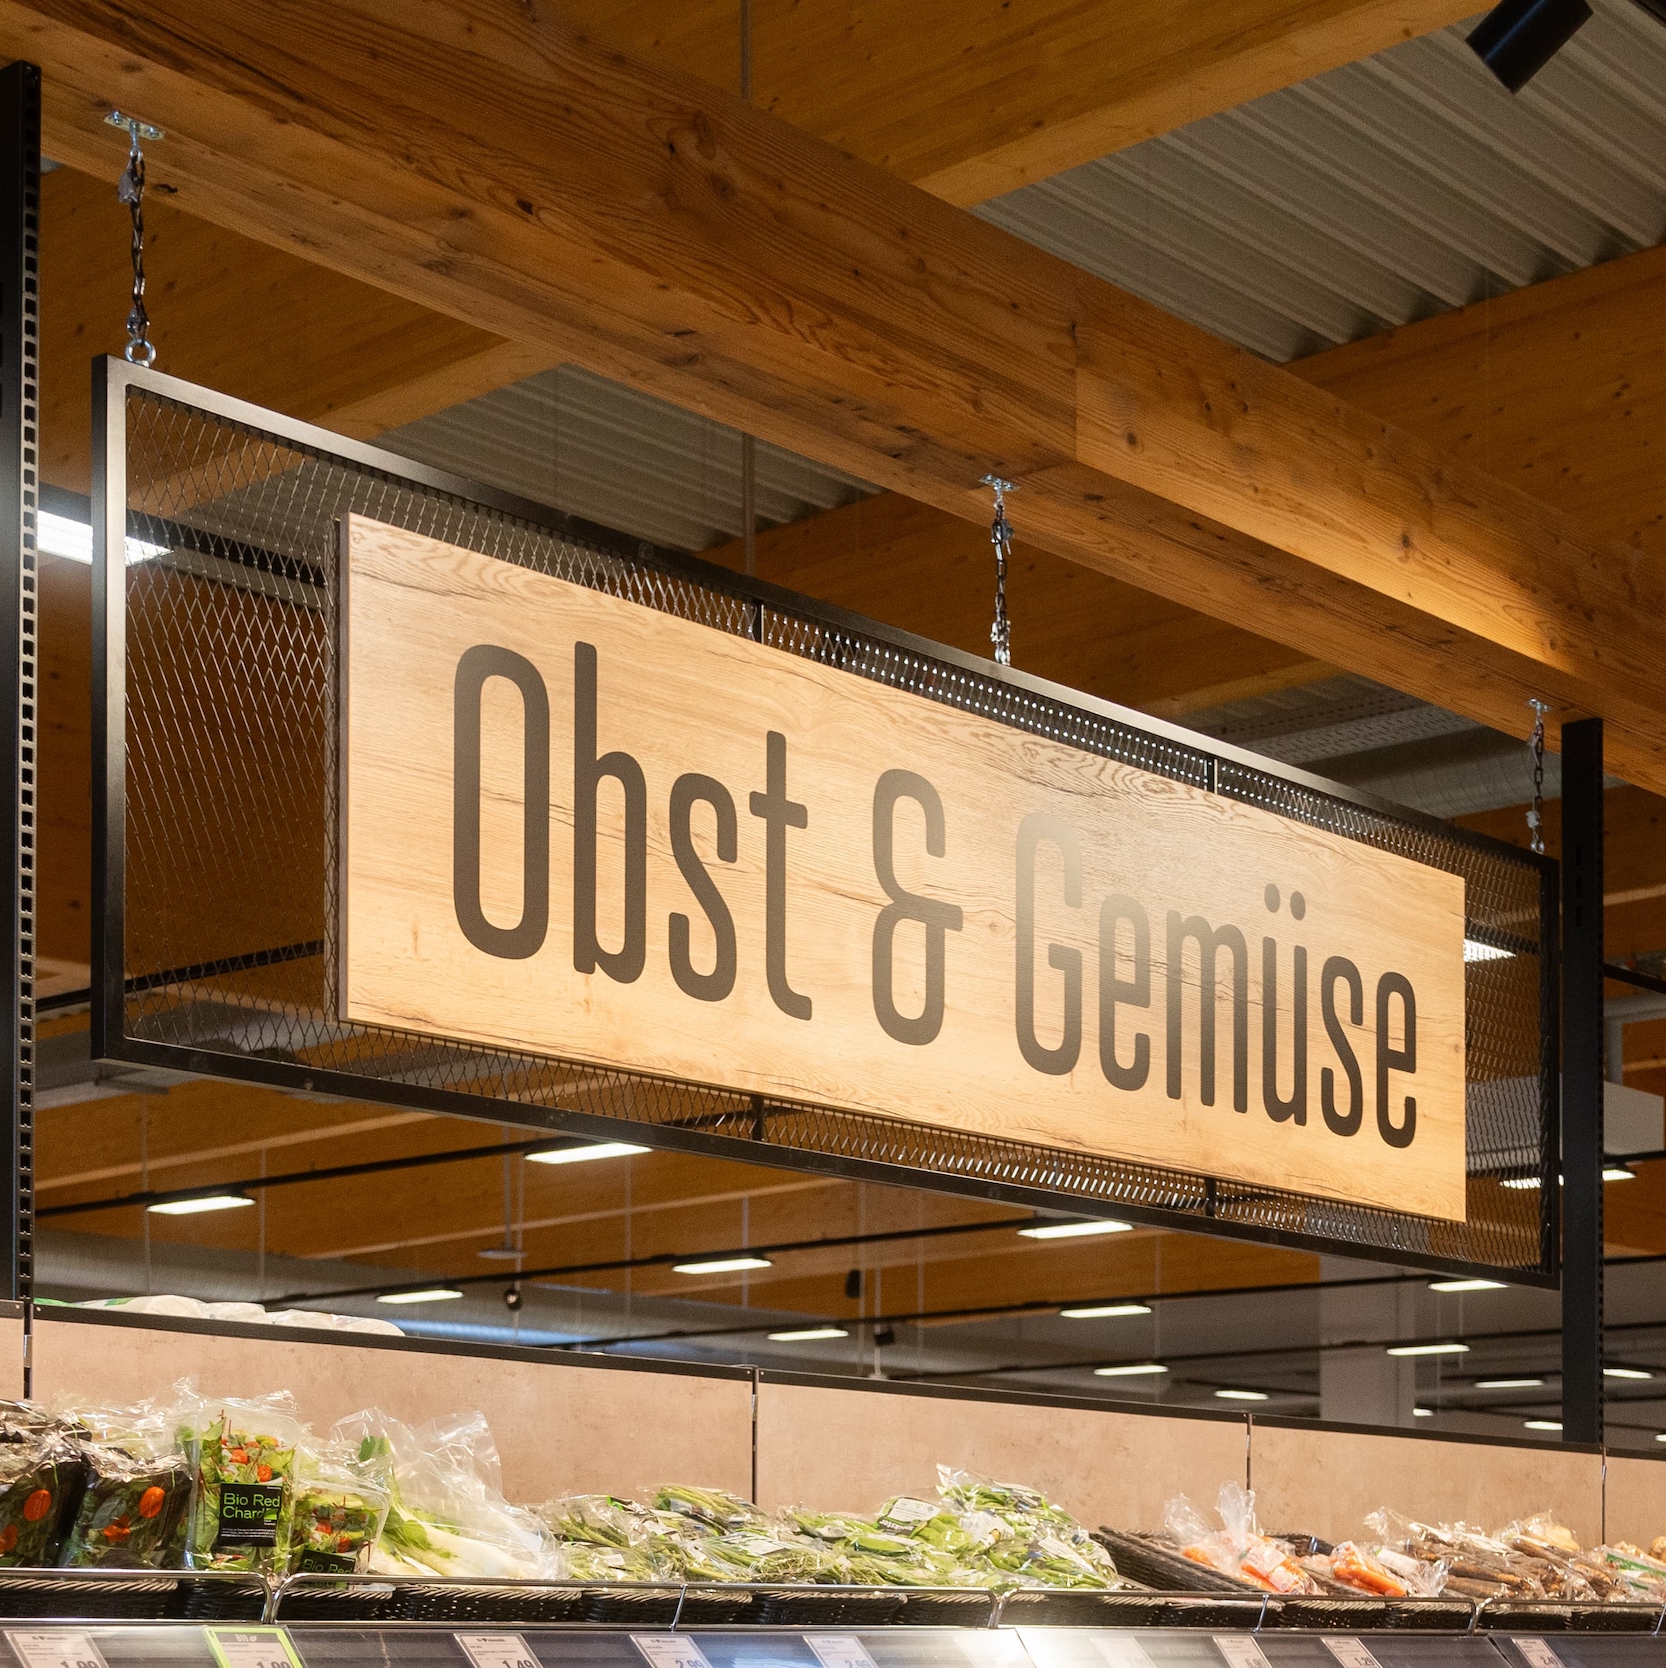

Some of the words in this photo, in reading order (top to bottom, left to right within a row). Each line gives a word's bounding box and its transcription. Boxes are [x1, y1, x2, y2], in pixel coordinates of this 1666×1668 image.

[452, 640, 813, 1022] Obst
[871, 767, 963, 1047] &
[1013, 812, 1418, 1150] Gemüse
[223, 1493, 249, 1506] Bio
[253, 1494, 281, 1507] Red
[302, 1558, 323, 1572] Bio
